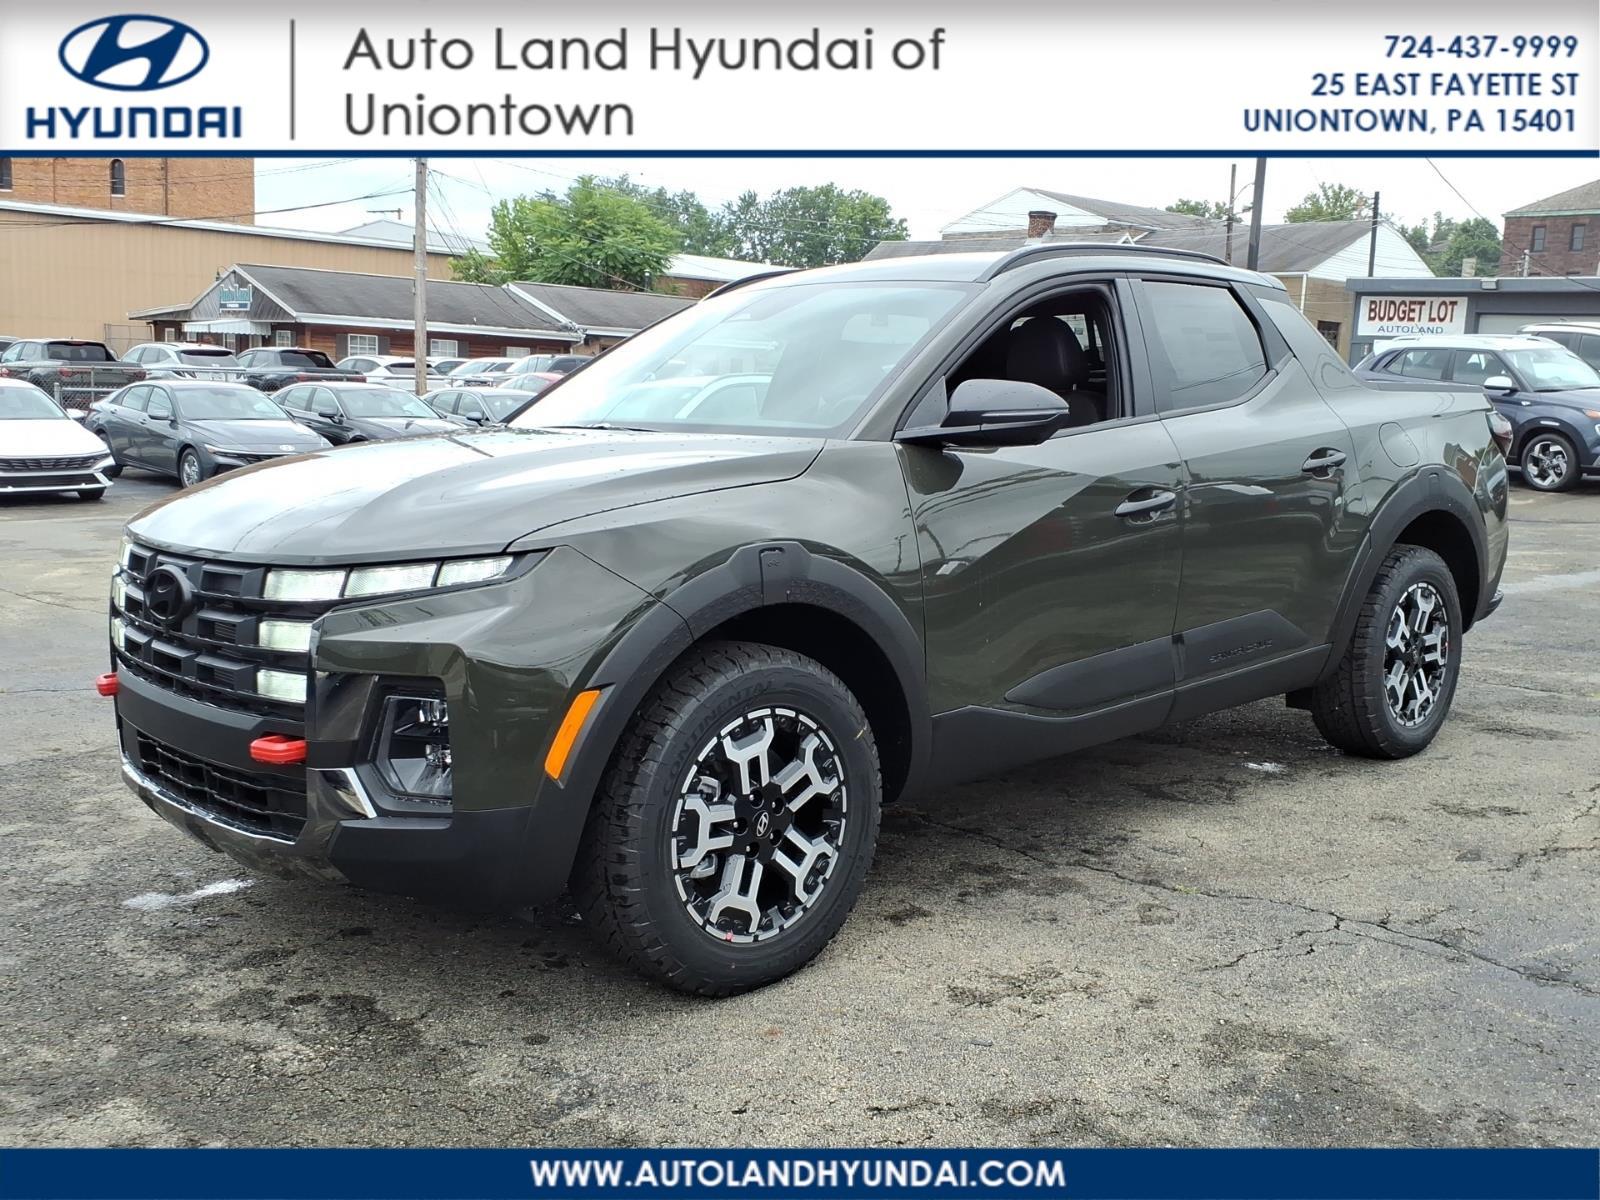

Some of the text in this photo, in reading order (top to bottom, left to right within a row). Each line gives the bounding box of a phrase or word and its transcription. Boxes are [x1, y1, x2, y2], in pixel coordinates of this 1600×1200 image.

[1368, 299, 1458, 323] BUDGET LOT
[1377, 325, 1443, 334] AUTOLAND
